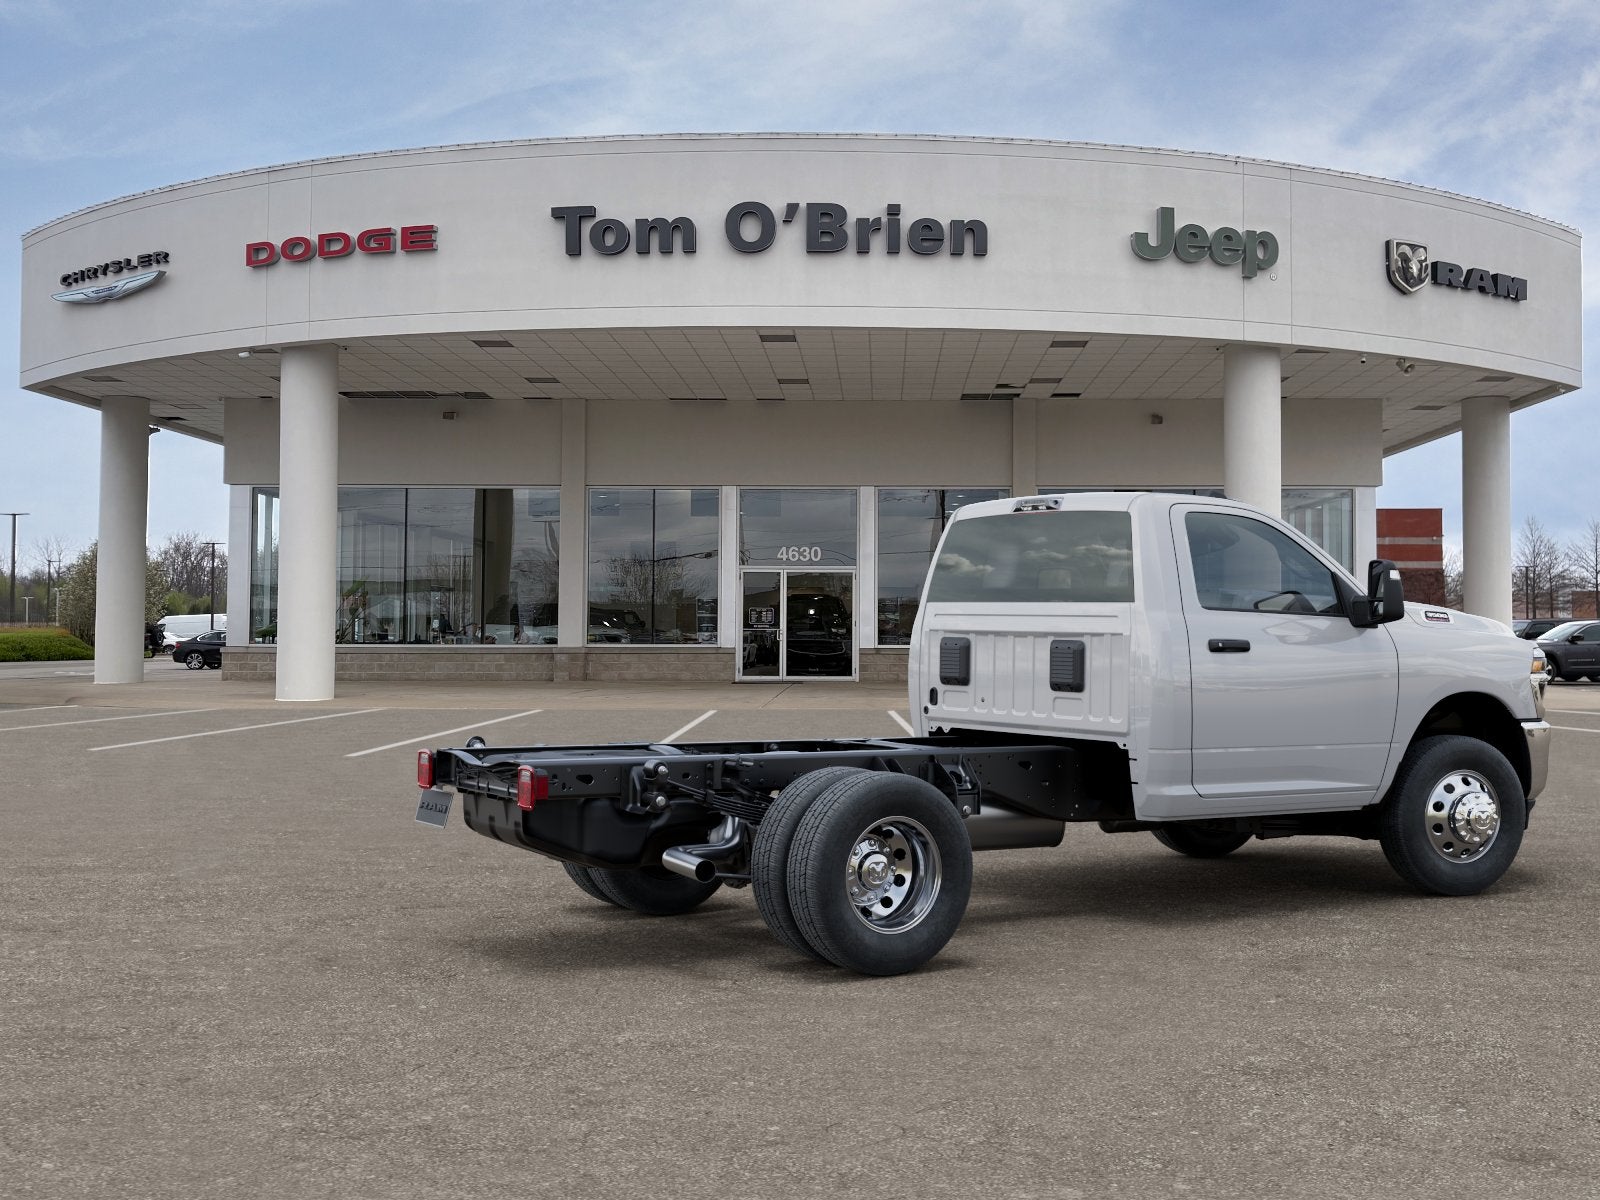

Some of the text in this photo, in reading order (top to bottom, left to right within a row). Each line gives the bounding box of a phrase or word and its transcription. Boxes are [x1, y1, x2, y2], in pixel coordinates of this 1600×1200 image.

[245, 224, 438, 269] DODGE
[551, 200, 989, 257] Tom O'Brien
[1130, 206, 1279, 279] Jeep
[60, 250, 170, 287] CHRYSLER
[1430, 260, 1528, 302] RAM
[776, 546, 822, 562] 4630
